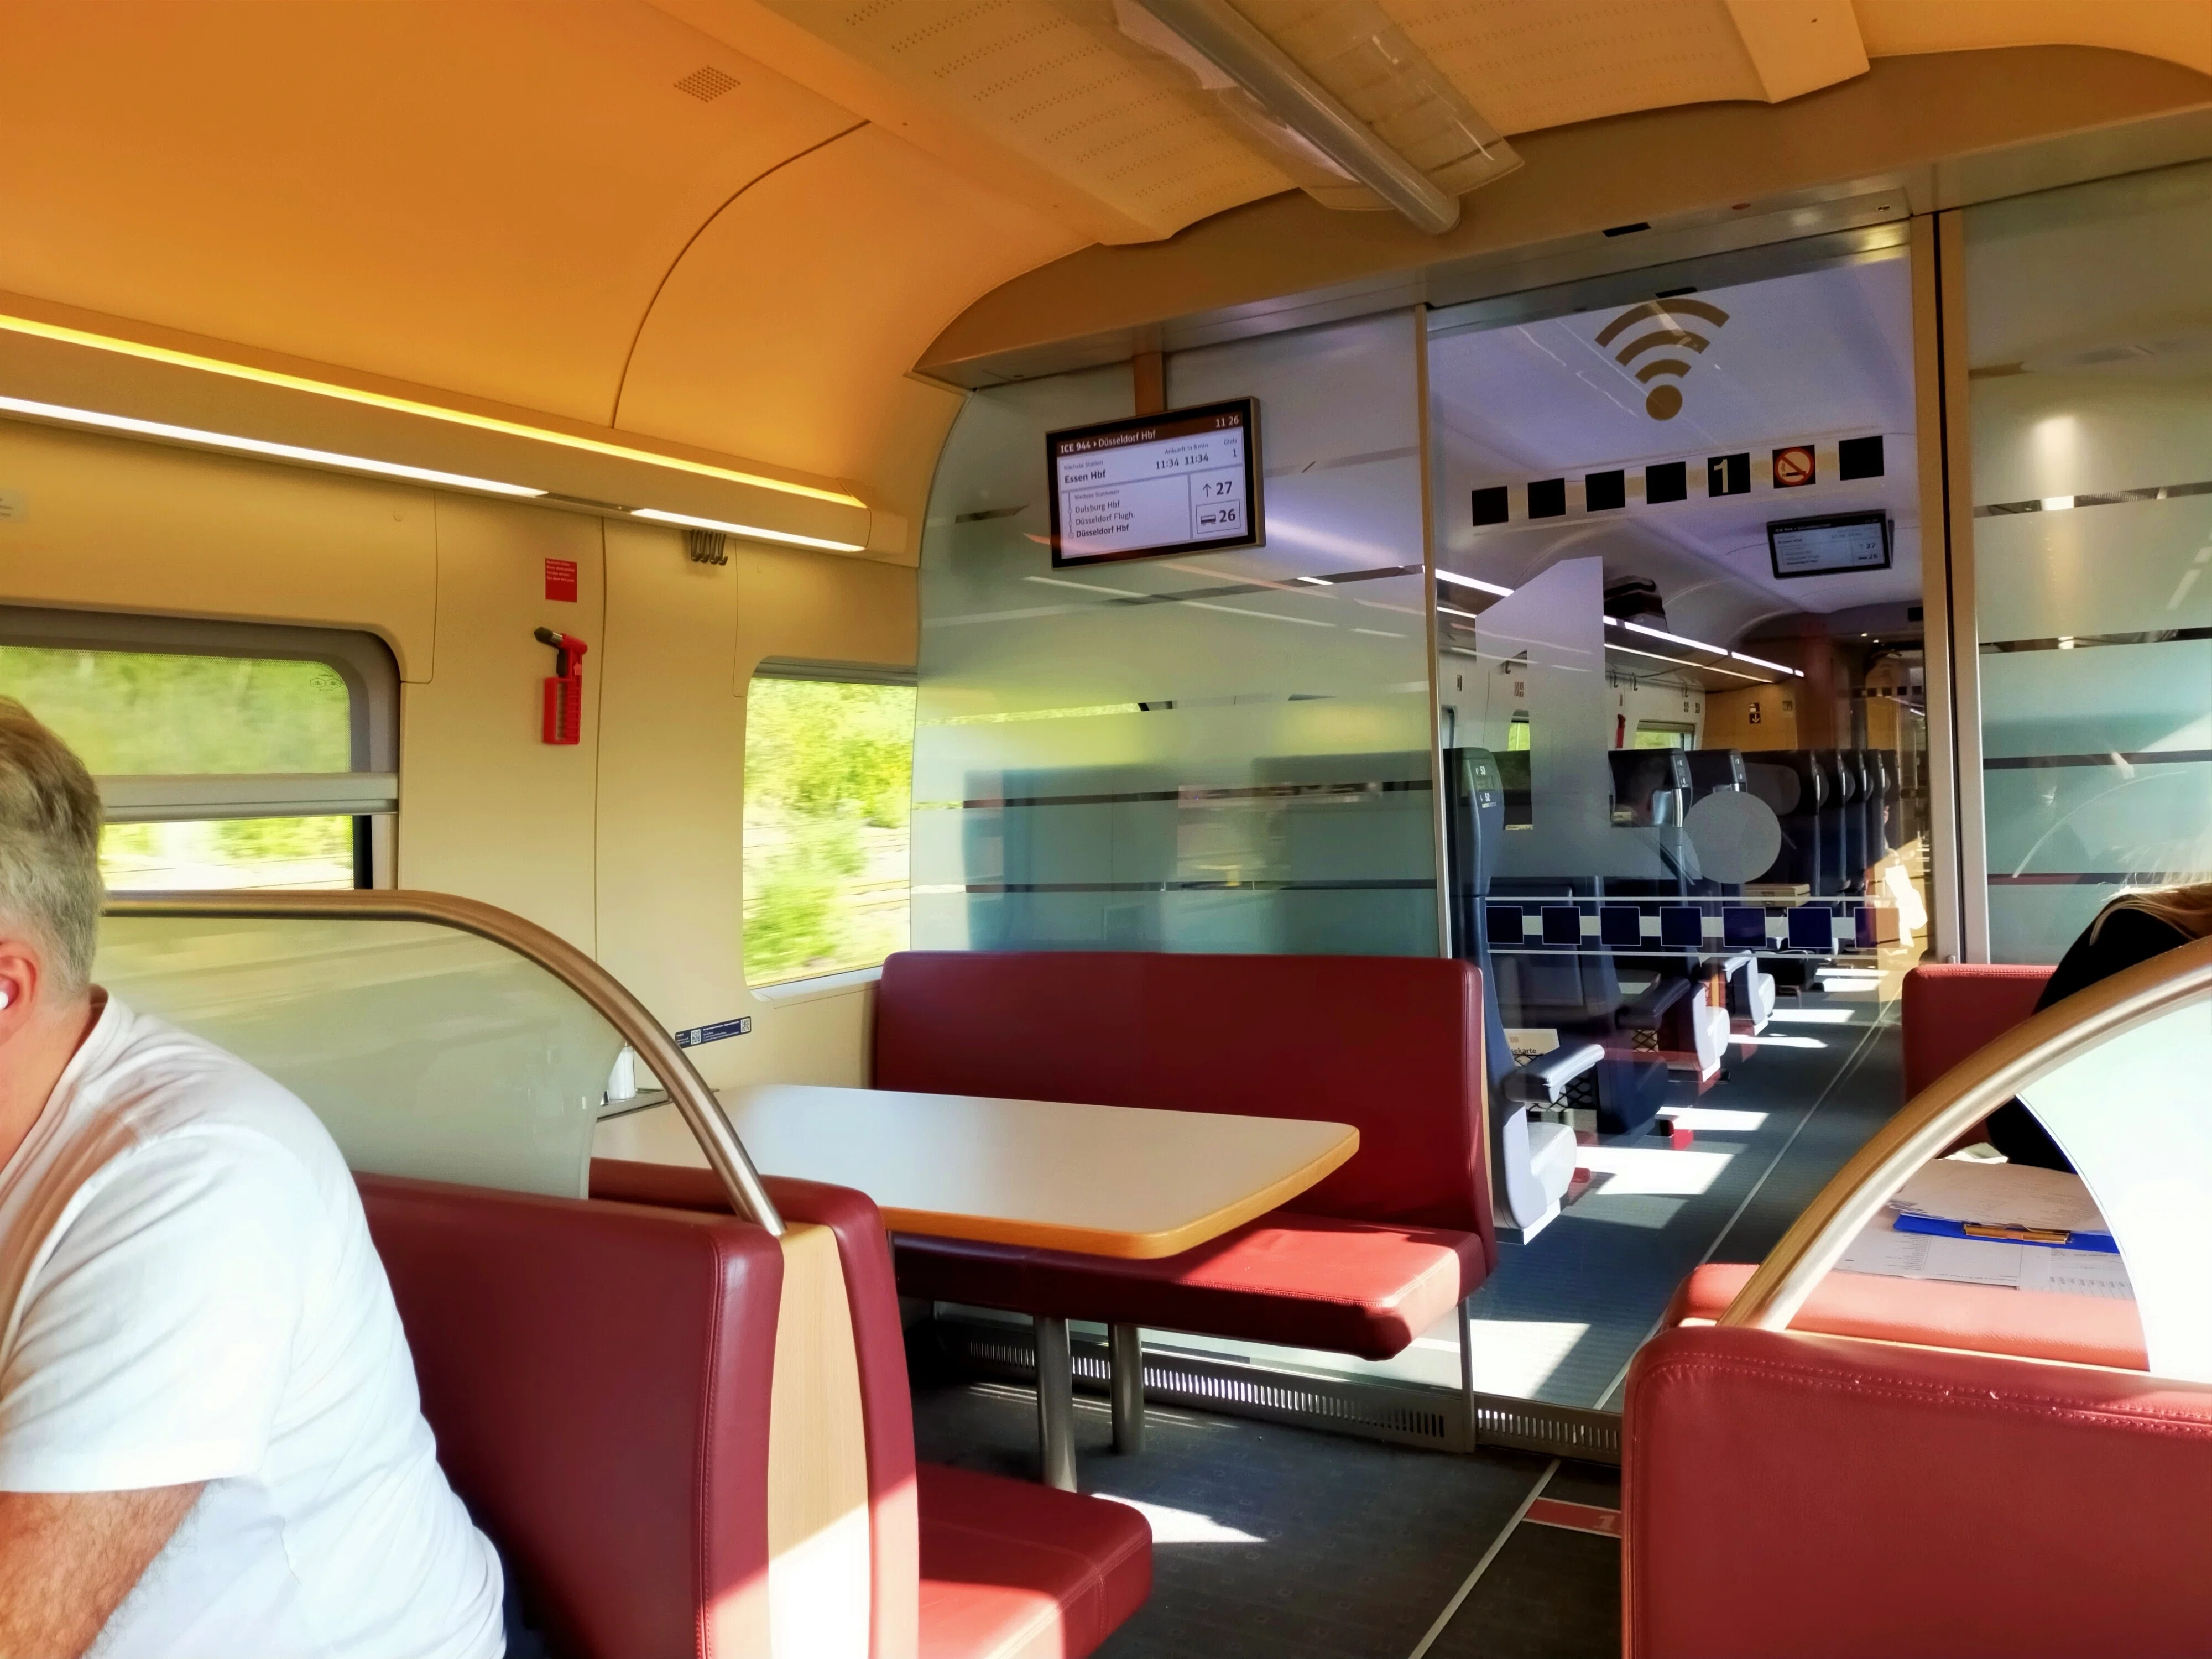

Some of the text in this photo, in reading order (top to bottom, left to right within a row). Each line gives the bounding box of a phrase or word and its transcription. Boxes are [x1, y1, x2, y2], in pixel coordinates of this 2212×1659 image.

[1061, 429, 1156, 453] ICE 944 Düsseldorf Hbf
[1223, 437, 1237, 445] Gleis
[1165, 446, 1186, 455] Ankunft
[1232, 449, 1237, 457] 1
[1156, 453, 1209, 469] 11:34 11:34
[1065, 469, 1106, 484] Essen Hbf
[1713, 458, 1729, 493] 1
[1216, 481, 1233, 495] 27
[1075, 500, 1120, 513] Duisburg Hbf
[1076, 511, 1135, 525] Düsseldorf Flugh.
[1219, 508, 1236, 523] 26
[1076, 524, 1129, 538] Düsseldorf Hbf
